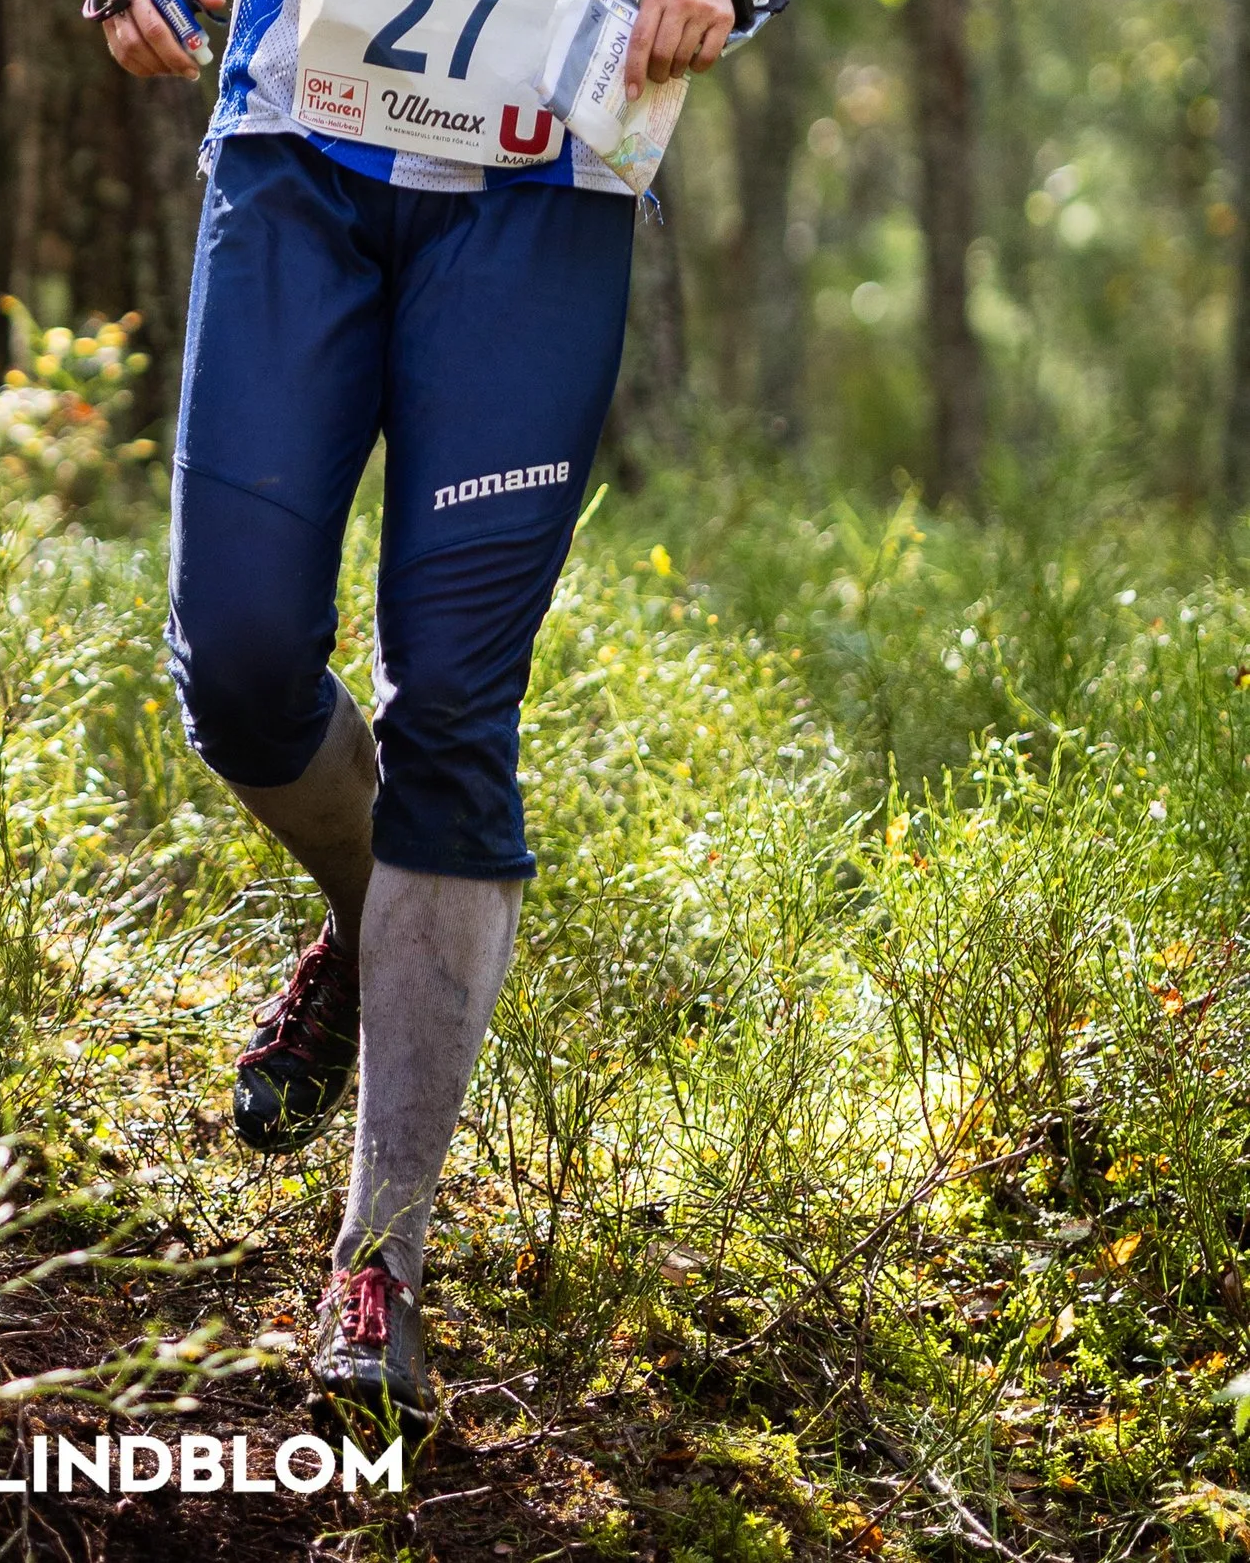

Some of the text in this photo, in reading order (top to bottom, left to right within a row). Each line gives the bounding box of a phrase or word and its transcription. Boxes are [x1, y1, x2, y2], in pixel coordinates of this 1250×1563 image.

[591, 31, 628, 104] RÄVSJÖN
[307, 93, 362, 119] Tisaren
[381, 89, 485, 134] Ullmax
[434, 461, 569, 510] noname
